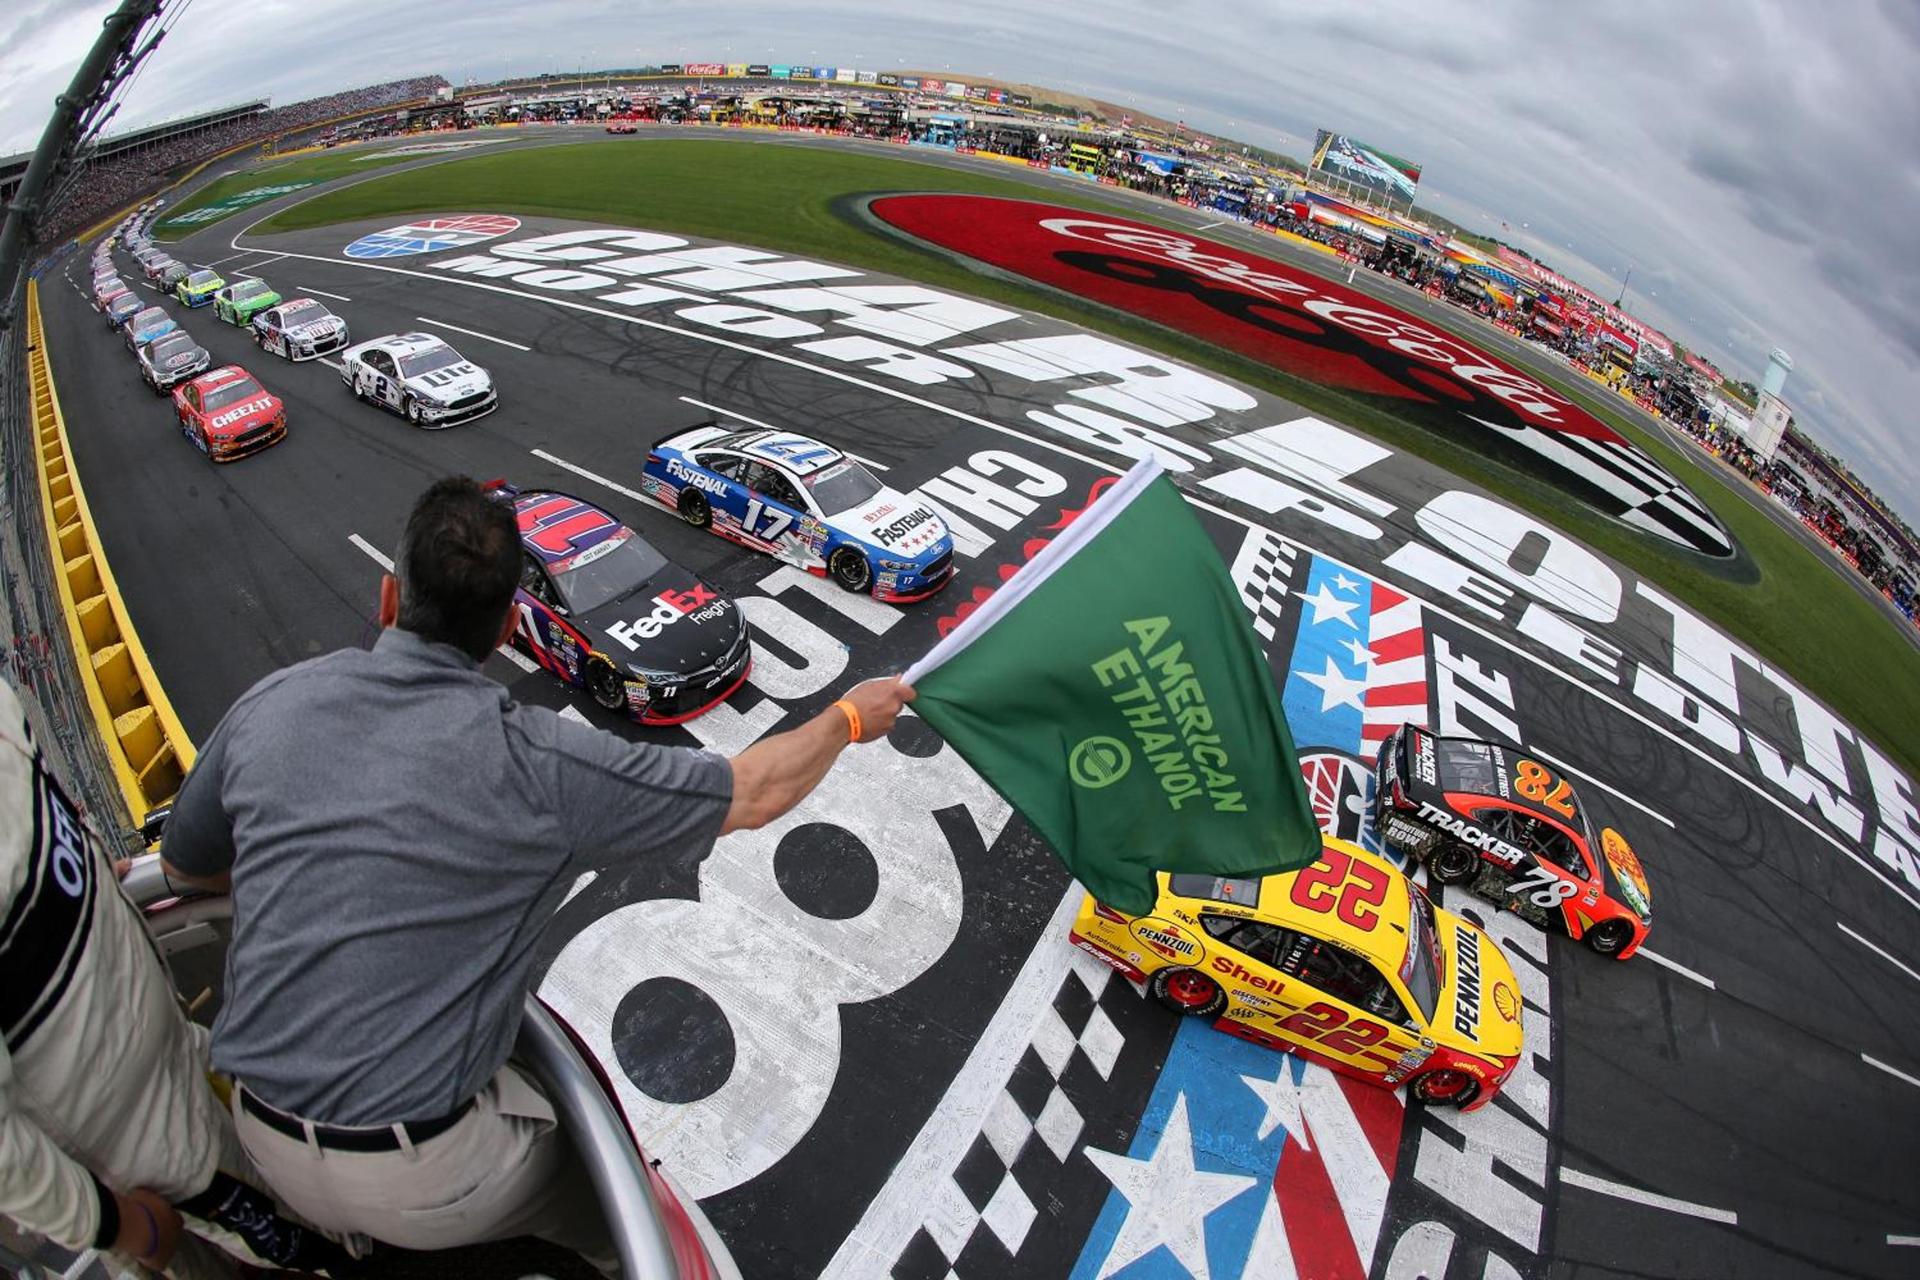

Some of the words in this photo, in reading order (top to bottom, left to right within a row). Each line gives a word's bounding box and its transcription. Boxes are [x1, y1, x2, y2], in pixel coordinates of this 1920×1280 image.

[688, 65, 722, 76] Coca-Cola
[1038, 217, 1567, 423] Coca-Cola
[375, 375, 388, 400] 2
[212, 397, 273, 428] CHEEZ-IT
[665, 458, 727, 499] FASTENAL
[742, 498, 794, 541] 17
[871, 507, 935, 547] FASTENAL
[489, 229, 1920, 853] CHARLOTTE
[427, 254, 977, 386] MOTOR
[1026, 403, 1920, 892] SPEEDWA
[903, 576, 915, 585] 17
[604, 582, 718, 652] FedEx
[688, 598, 732, 626] Freight
[663, 686, 677, 697] 11
[1091, 647, 1203, 811] ETHANOL
[1123, 616, 1248, 812] AMERICAN
[1420, 733, 1436, 787] TRACKER
[1514, 759, 1576, 820] 78
[1386, 827, 1421, 847] ROW
[1388, 817, 1430, 840] FURNITURE
[1416, 801, 1527, 866] TRACKER
[1290, 845, 1391, 933] 22
[1505, 866, 1578, 908] 78
[1172, 909, 1199, 925] SKF
[1084, 931, 1128, 955] Autotrader
[1137, 926, 1195, 956] PENNZOIL
[1211, 956, 1287, 996] Shell
[1455, 925, 1479, 1042] PENNZOIL
[1230, 988, 1272, 1007] DISCOUNT
[1274, 1001, 1390, 1055] 22
